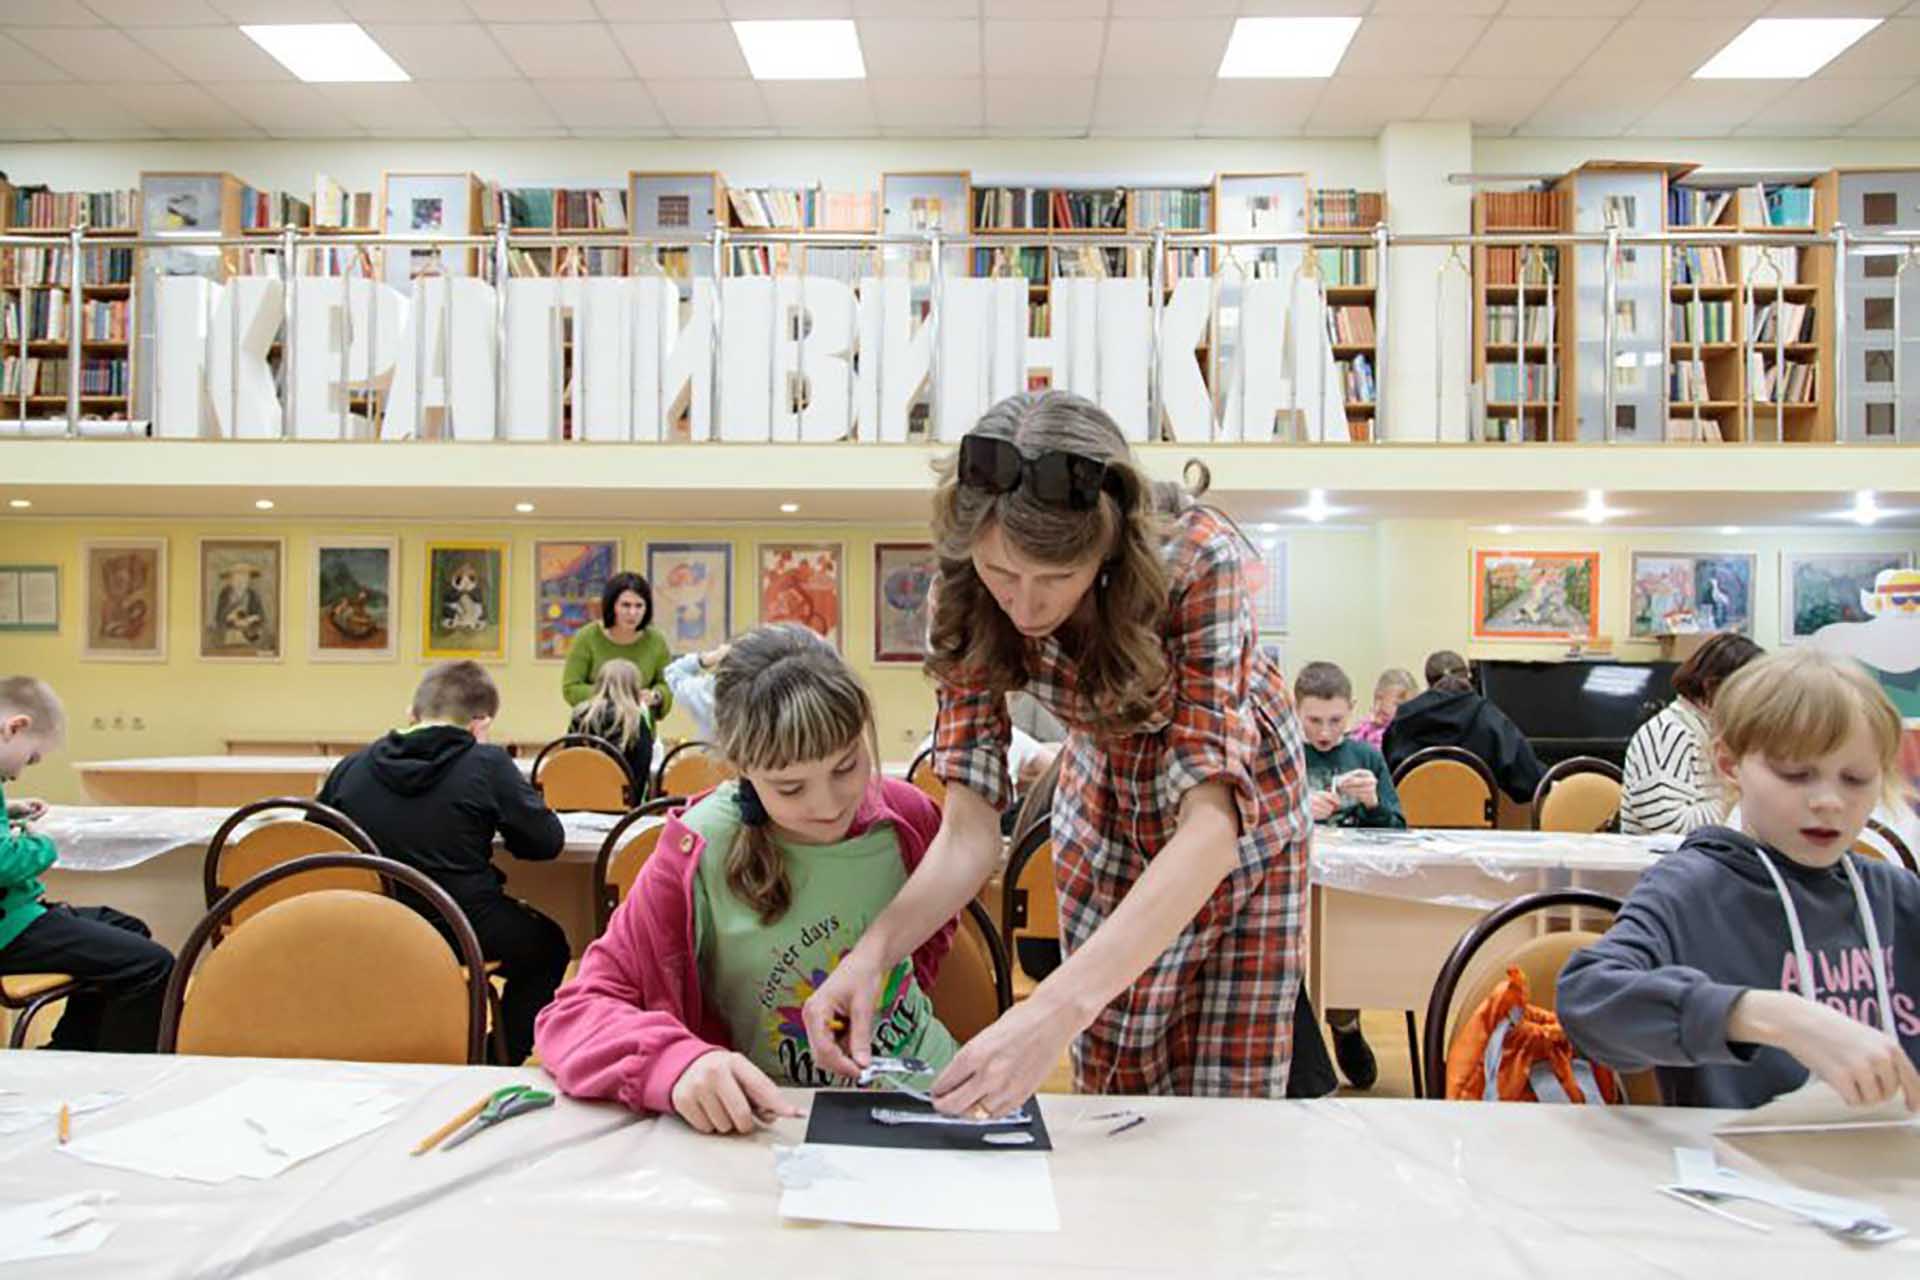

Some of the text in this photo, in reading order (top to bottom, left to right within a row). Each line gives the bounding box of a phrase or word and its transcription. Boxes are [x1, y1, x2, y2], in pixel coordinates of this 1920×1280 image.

[156, 275, 1351, 442] КРАПИВИНКА
[761, 915, 841, 1010] forever days
